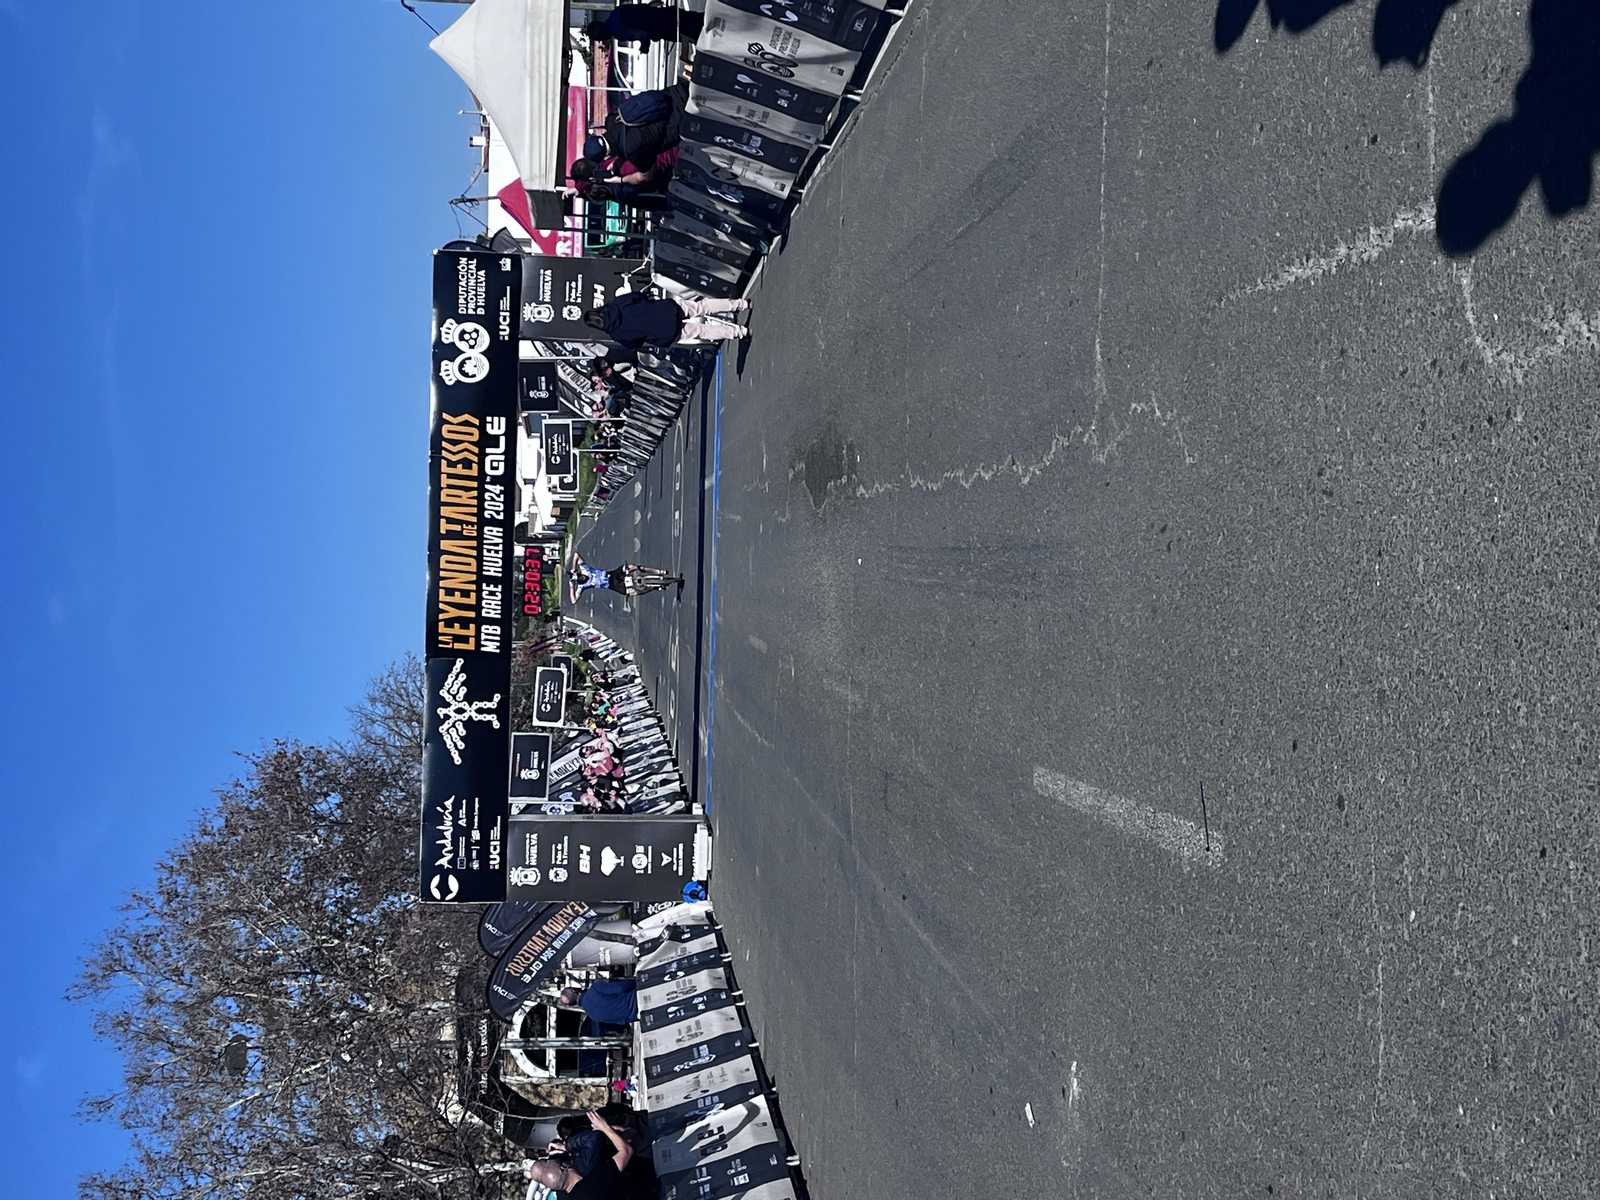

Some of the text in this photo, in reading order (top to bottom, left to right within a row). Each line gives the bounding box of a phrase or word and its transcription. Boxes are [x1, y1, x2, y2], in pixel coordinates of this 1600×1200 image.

[457, 257, 468, 314] DIPUTACIÓN
[468, 258, 476, 314] PROVINCIAL
[477, 270, 486, 306] HUELVA
[544, 270, 552, 302] HUELVA
[500, 311, 510, 336] UCI
[440, 412, 480, 534] TARTESSOS
[484, 484, 504, 520] 2024
[463, 524, 478, 536] DE
[483, 526, 503, 577] HUELVA
[438, 540, 477, 650] LEYENDA
[524, 548, 541, 614] 02:30:37
[482, 583, 502, 618] RACE
[438, 636, 453, 648] LA
[480, 624, 500, 653] MTB
[434, 795, 455, 869] Andalucía
[530, 833, 538, 865] HUELVA
[489, 841, 500, 864] UCI
[580, 844, 590, 873] BH
